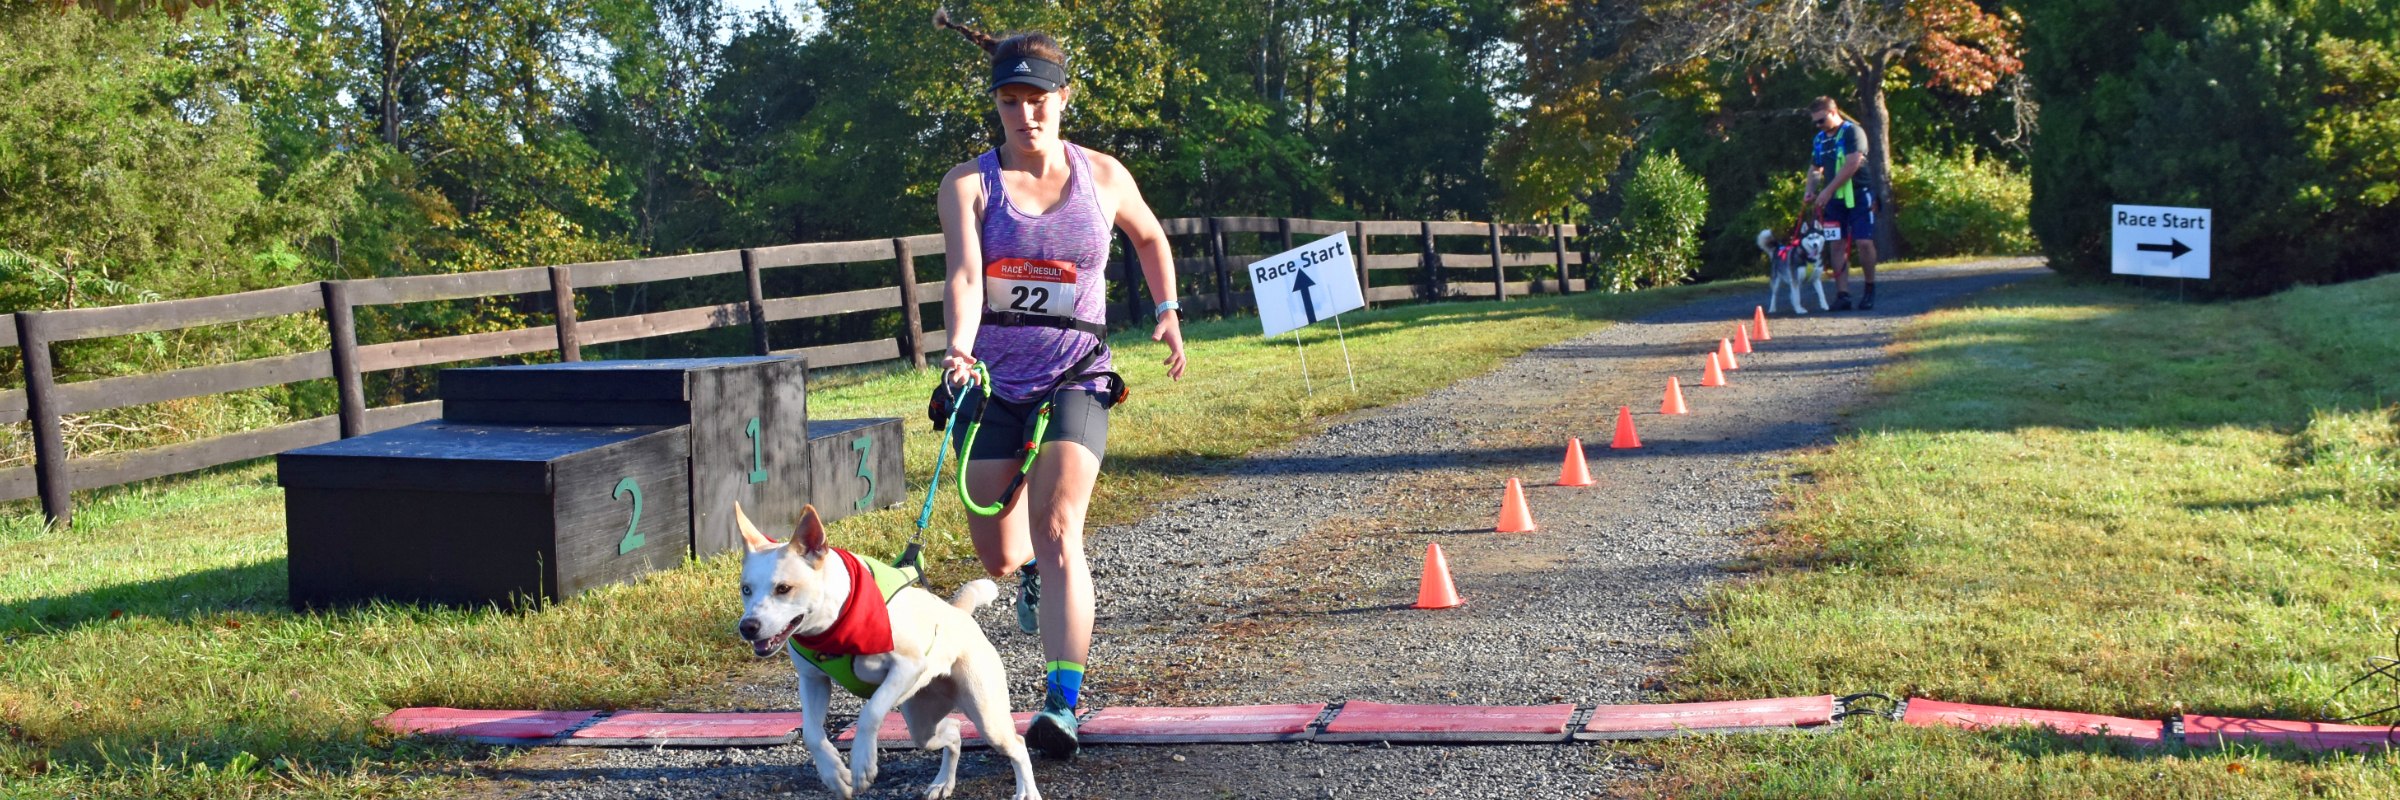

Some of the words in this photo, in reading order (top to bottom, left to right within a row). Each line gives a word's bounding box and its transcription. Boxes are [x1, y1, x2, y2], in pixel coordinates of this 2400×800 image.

[2117, 211, 2157, 227] Race
[2162, 212, 2205, 229] Start
[1001, 265, 1023, 274] RACE
[1033, 266, 1063, 277] RESULT
[1255, 260, 1297, 284] Race
[1300, 241, 1344, 268] Start
[1010, 285, 1049, 313] 22
[745, 417, 767, 484] 1
[852, 435, 875, 510] 3
[612, 476, 645, 555] 2
